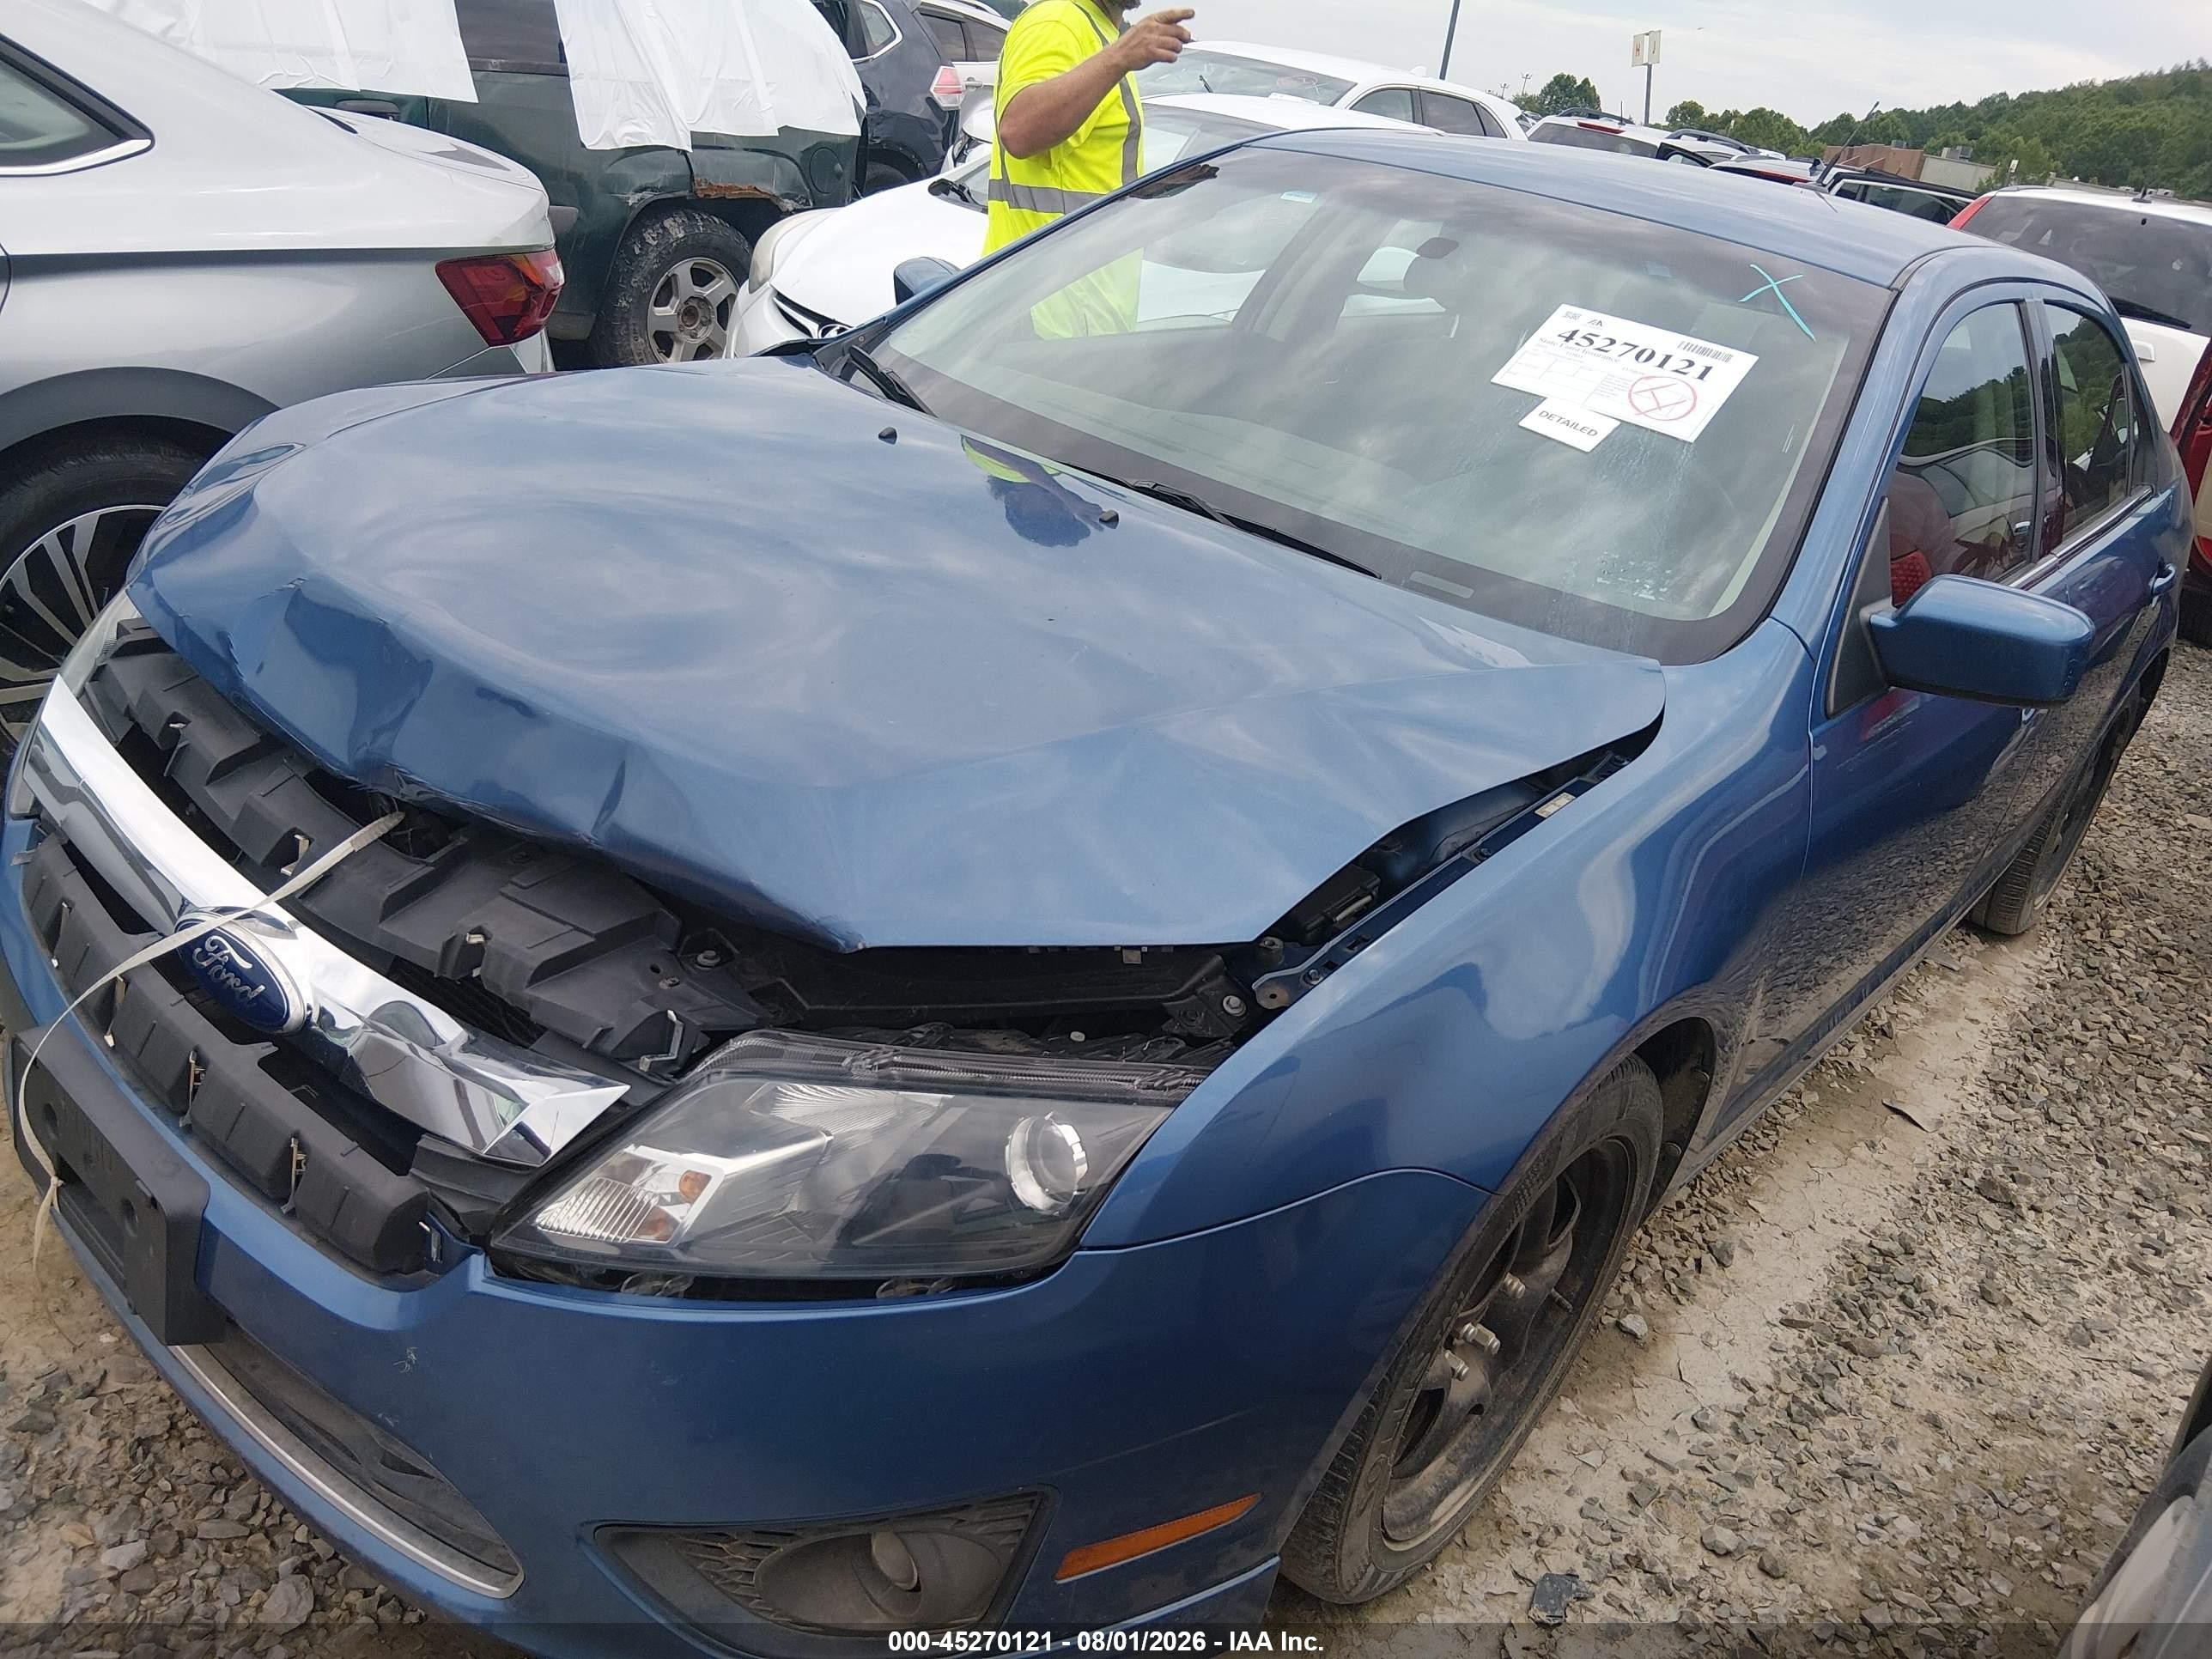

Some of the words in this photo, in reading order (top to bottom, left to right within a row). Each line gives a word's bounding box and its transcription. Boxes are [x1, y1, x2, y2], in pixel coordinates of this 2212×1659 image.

[1635, 43, 1641, 57] H
[1652, 40, 1656, 54] J
[1557, 329, 1713, 381] 45270121
[1538, 410, 1598, 436] DETAILED
[192, 935, 266, 1000] Ford
